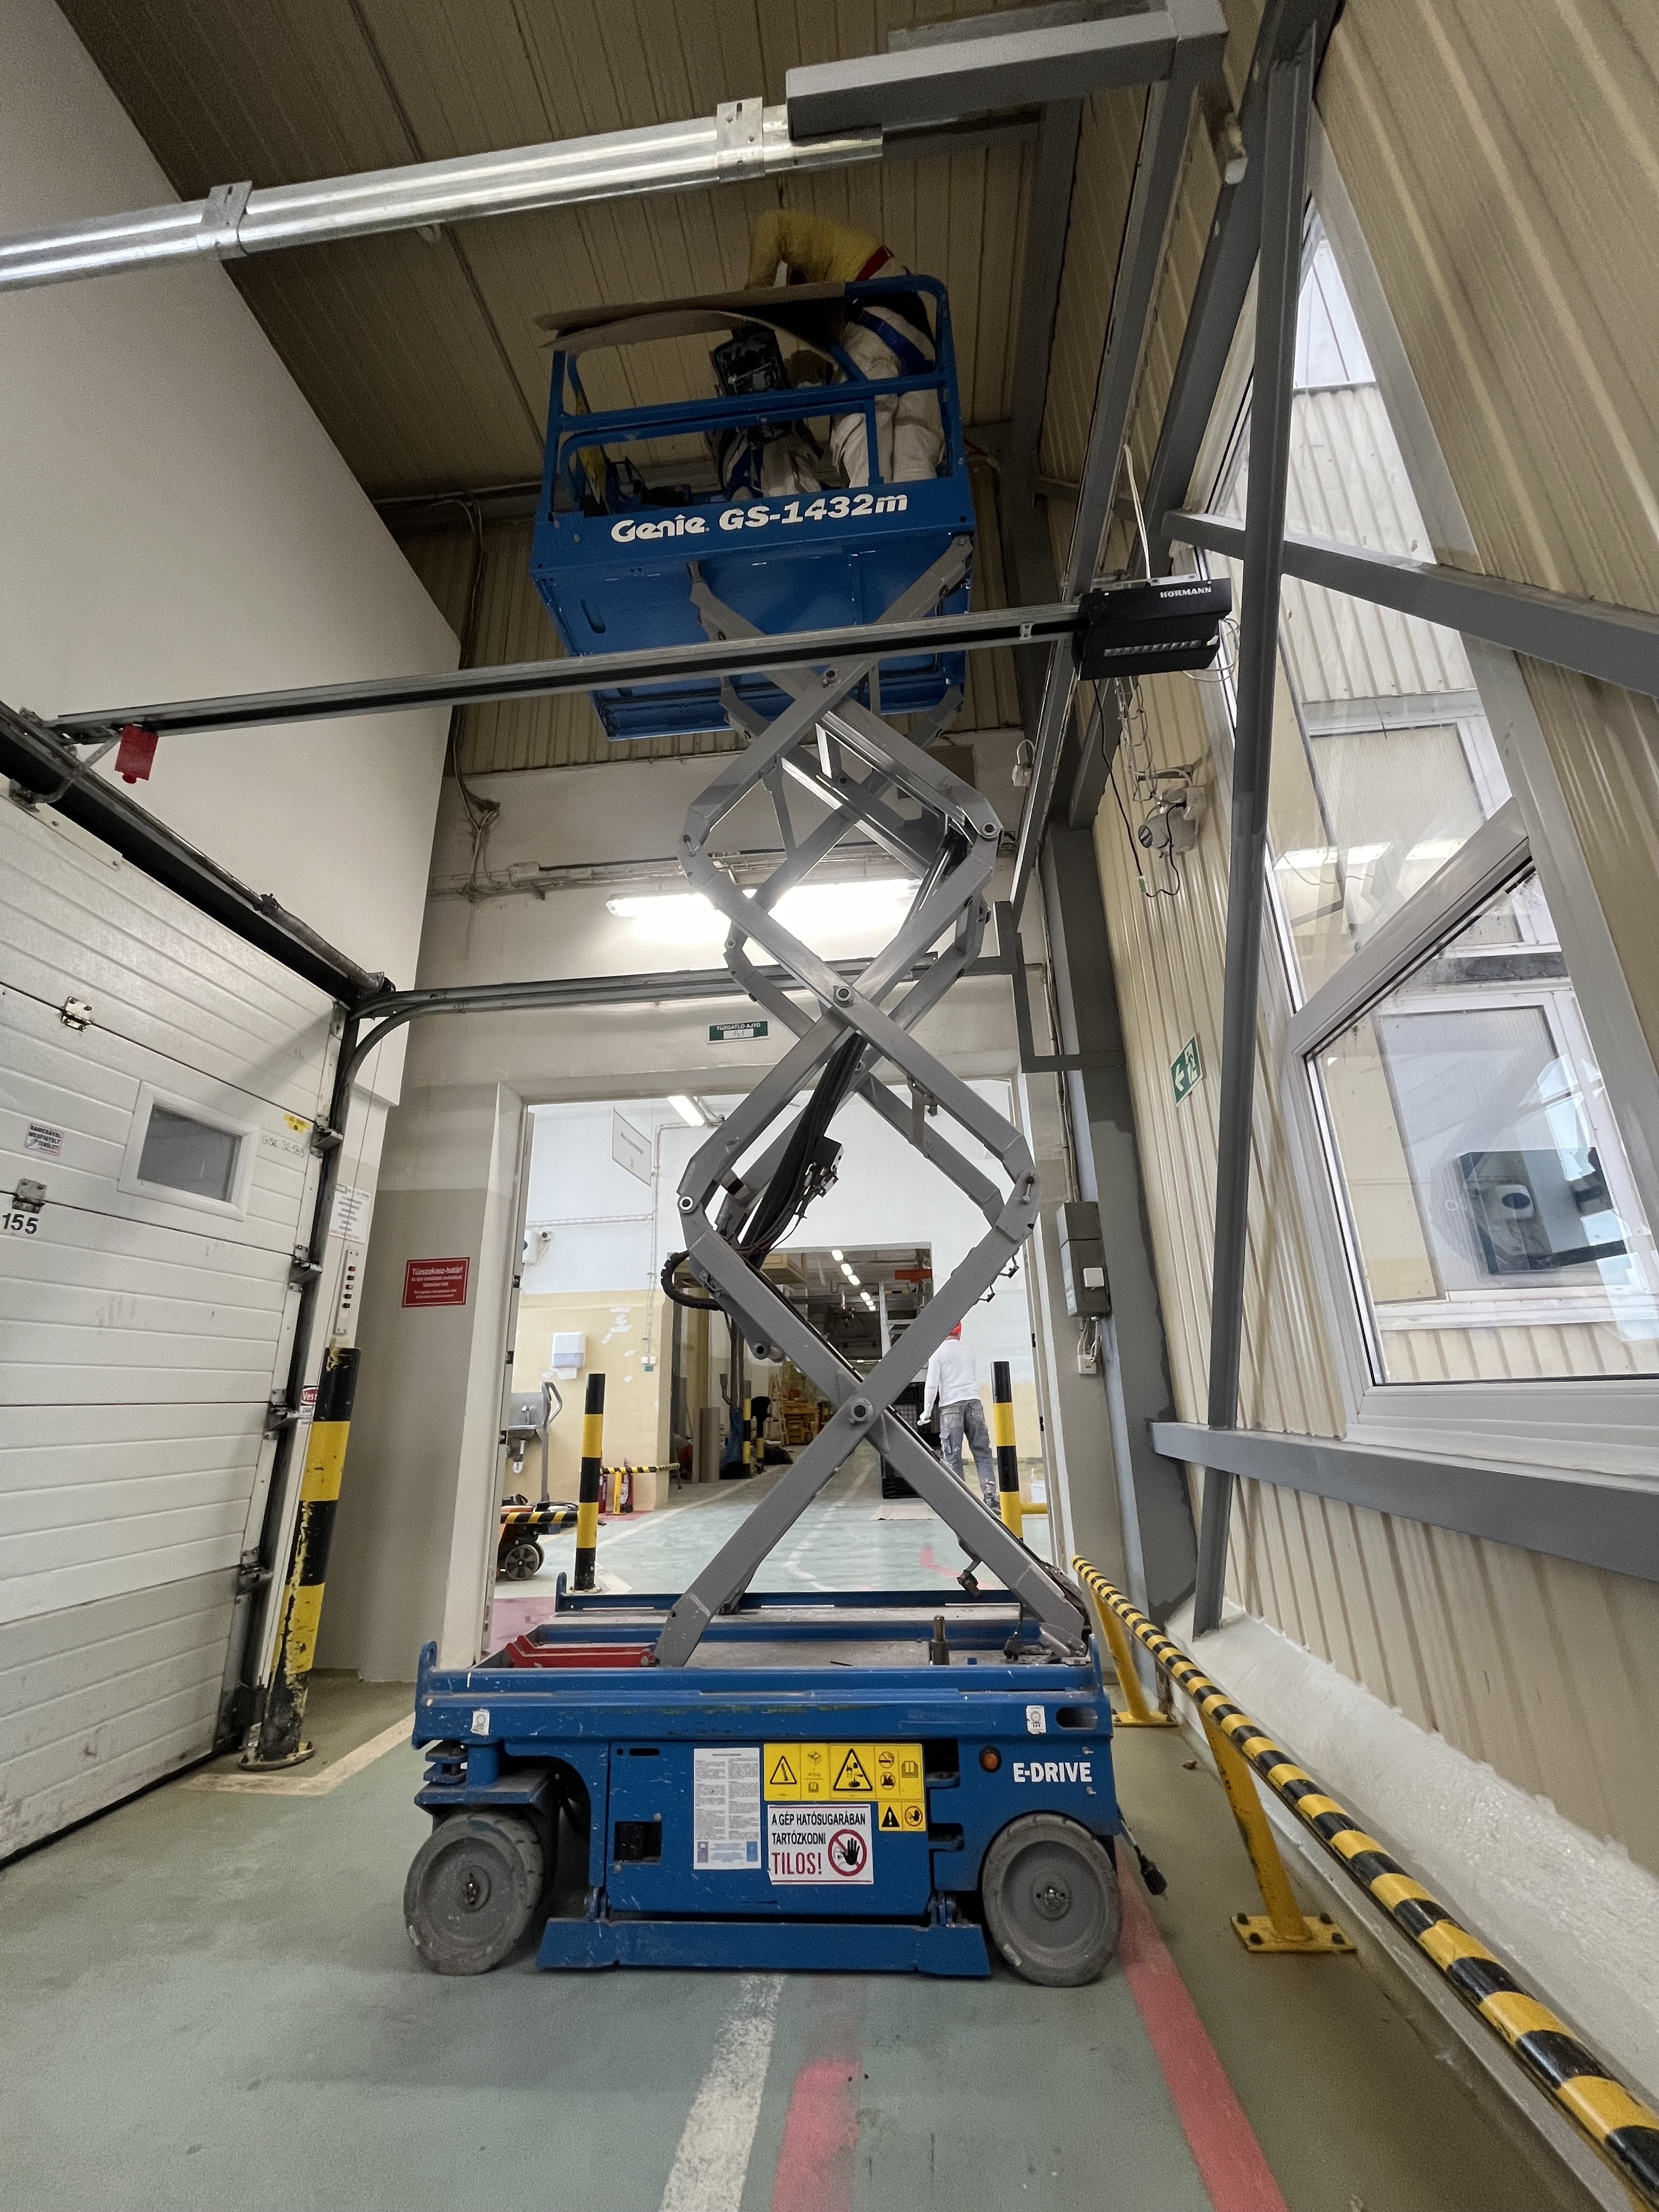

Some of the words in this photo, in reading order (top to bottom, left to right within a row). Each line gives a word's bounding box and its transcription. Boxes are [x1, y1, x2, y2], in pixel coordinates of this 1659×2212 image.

[611, 514, 706, 543] Genie
[719, 494, 909, 531] GS-1432m
[3, 1213, 39, 1234] 155
[1013, 1762, 1093, 1782] E-DRIVE
[771, 1814, 777, 1825] A
[778, 1811, 794, 1825] GÉP
[797, 1811, 866, 1825] HATÓSUGARÁBAN
[772, 1830, 826, 1844] TARTÓZKODNI
[771, 1852, 822, 1875] TILOS!
